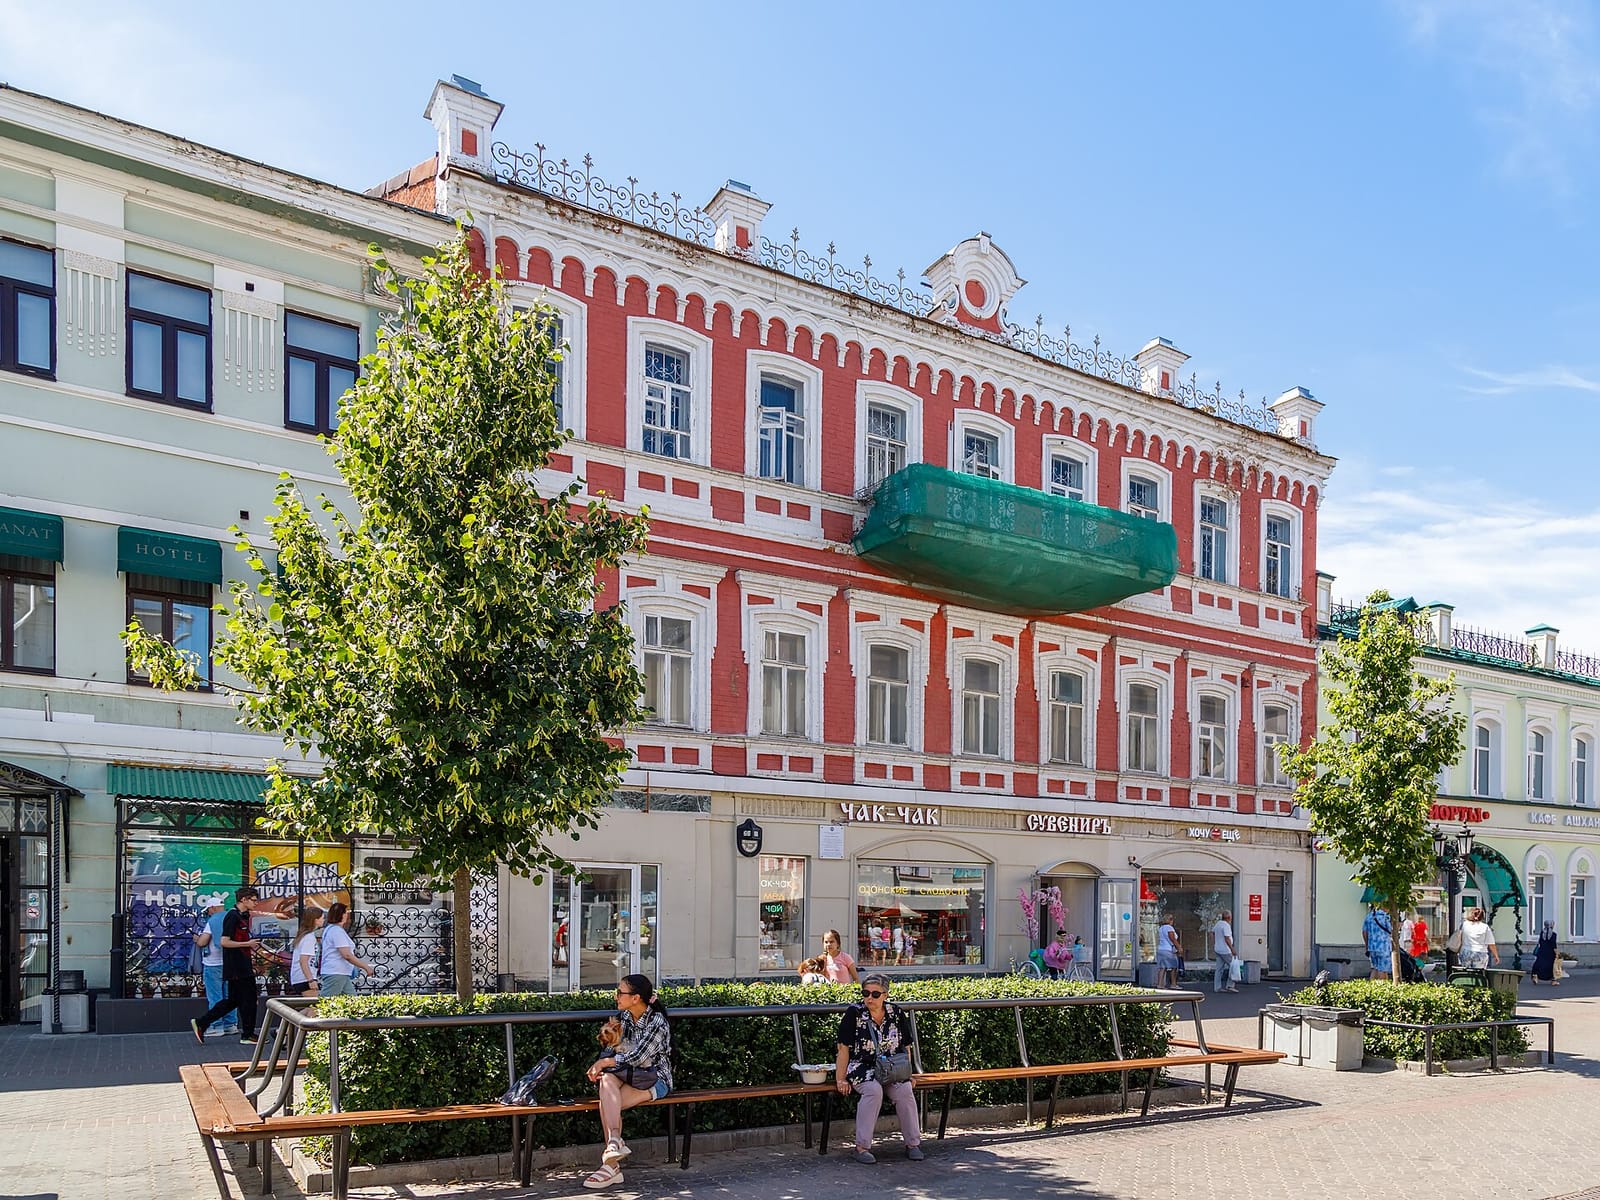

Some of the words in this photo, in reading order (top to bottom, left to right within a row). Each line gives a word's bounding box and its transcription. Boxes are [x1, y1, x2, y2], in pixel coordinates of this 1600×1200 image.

[135, 543, 208, 564] HOTEL
[840, 802, 939, 826] ЧАК-ЧАК
[1027, 813, 1112, 835] СУВЕНИРЪ
[1529, 811, 1557, 826] КАФЕ
[1188, 826, 1211, 838] ХОЧУ
